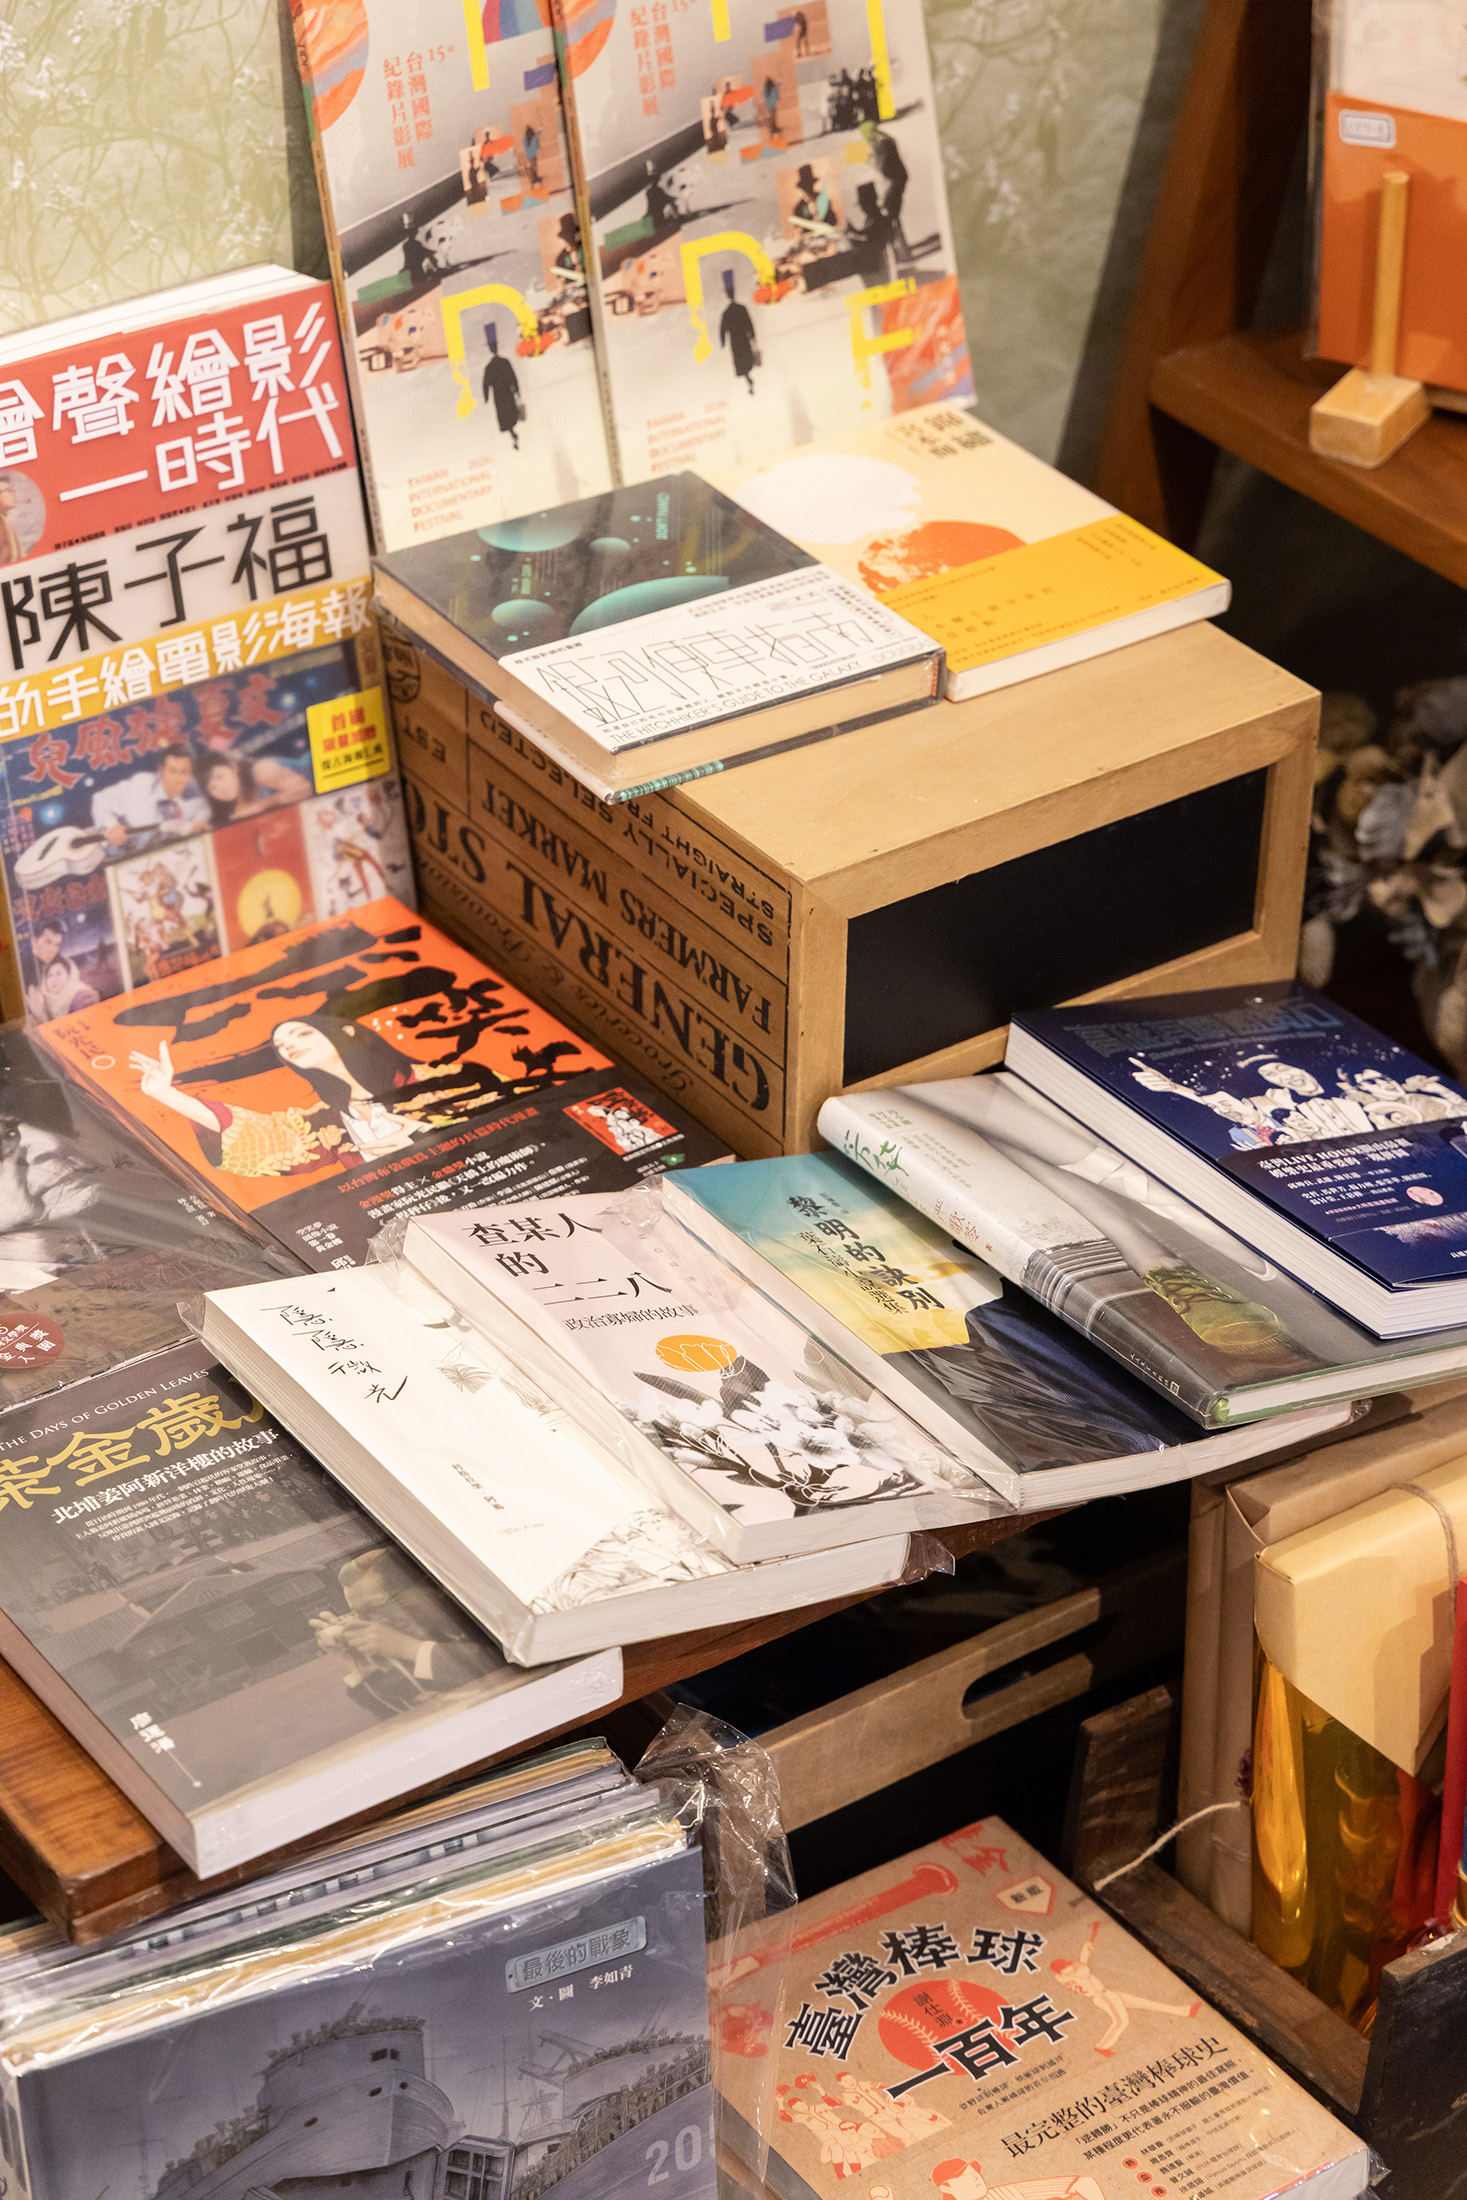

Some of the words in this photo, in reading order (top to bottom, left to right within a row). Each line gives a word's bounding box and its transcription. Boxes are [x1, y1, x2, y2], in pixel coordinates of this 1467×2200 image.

[383, 56, 416, 170] 紀錄片影展
[406, 51, 434, 143] 台灣國際
[59, 382, 344, 502] 一時代
[1, 496, 333, 670] 陳子福
[609, 728, 638, 744] THE
[639, 701, 724, 738] HITCHHIKER'S
[728, 685, 764, 708] GUIDE
[765, 683, 785, 697] TO
[785, 677, 809, 692] THE
[809, 660, 862, 684] GALAXY
[481, 778, 609, 908] MARKET
[622, 820, 774, 947] SPECIALLY
[661, 825, 775, 921] STRAIGHT
[506, 860, 771, 1112] GENERAL
[619, 887, 772, 1036] FARMERS
[462, 1212, 603, 1248] 查某人
[495, 1251, 550, 1277] 的
[785, 1195, 946, 1311] 黎明的訣別
[532, 1271, 673, 1306] 二二八
[561, 1303, 700, 1332] 政治寡婦的故事
[29, 1420, 69, 1440] DAYS
[71, 1412, 91, 1425] OF
[94, 1387, 158, 1416] GOLDEN
[160, 1368, 211, 1392] LEAVES
[51, 1428, 280, 1524] 北埔姜阿新洋樓的故事
[522, 1928, 631, 1982] 最後的戰象
[589, 1964, 634, 1991] 李如青
[783, 1923, 1048, 2061] 臺灣棒球
[884, 1992, 1079, 2100] 一百年
[1000, 2035, 1229, 2158] 最完整的臺灣棒球史
